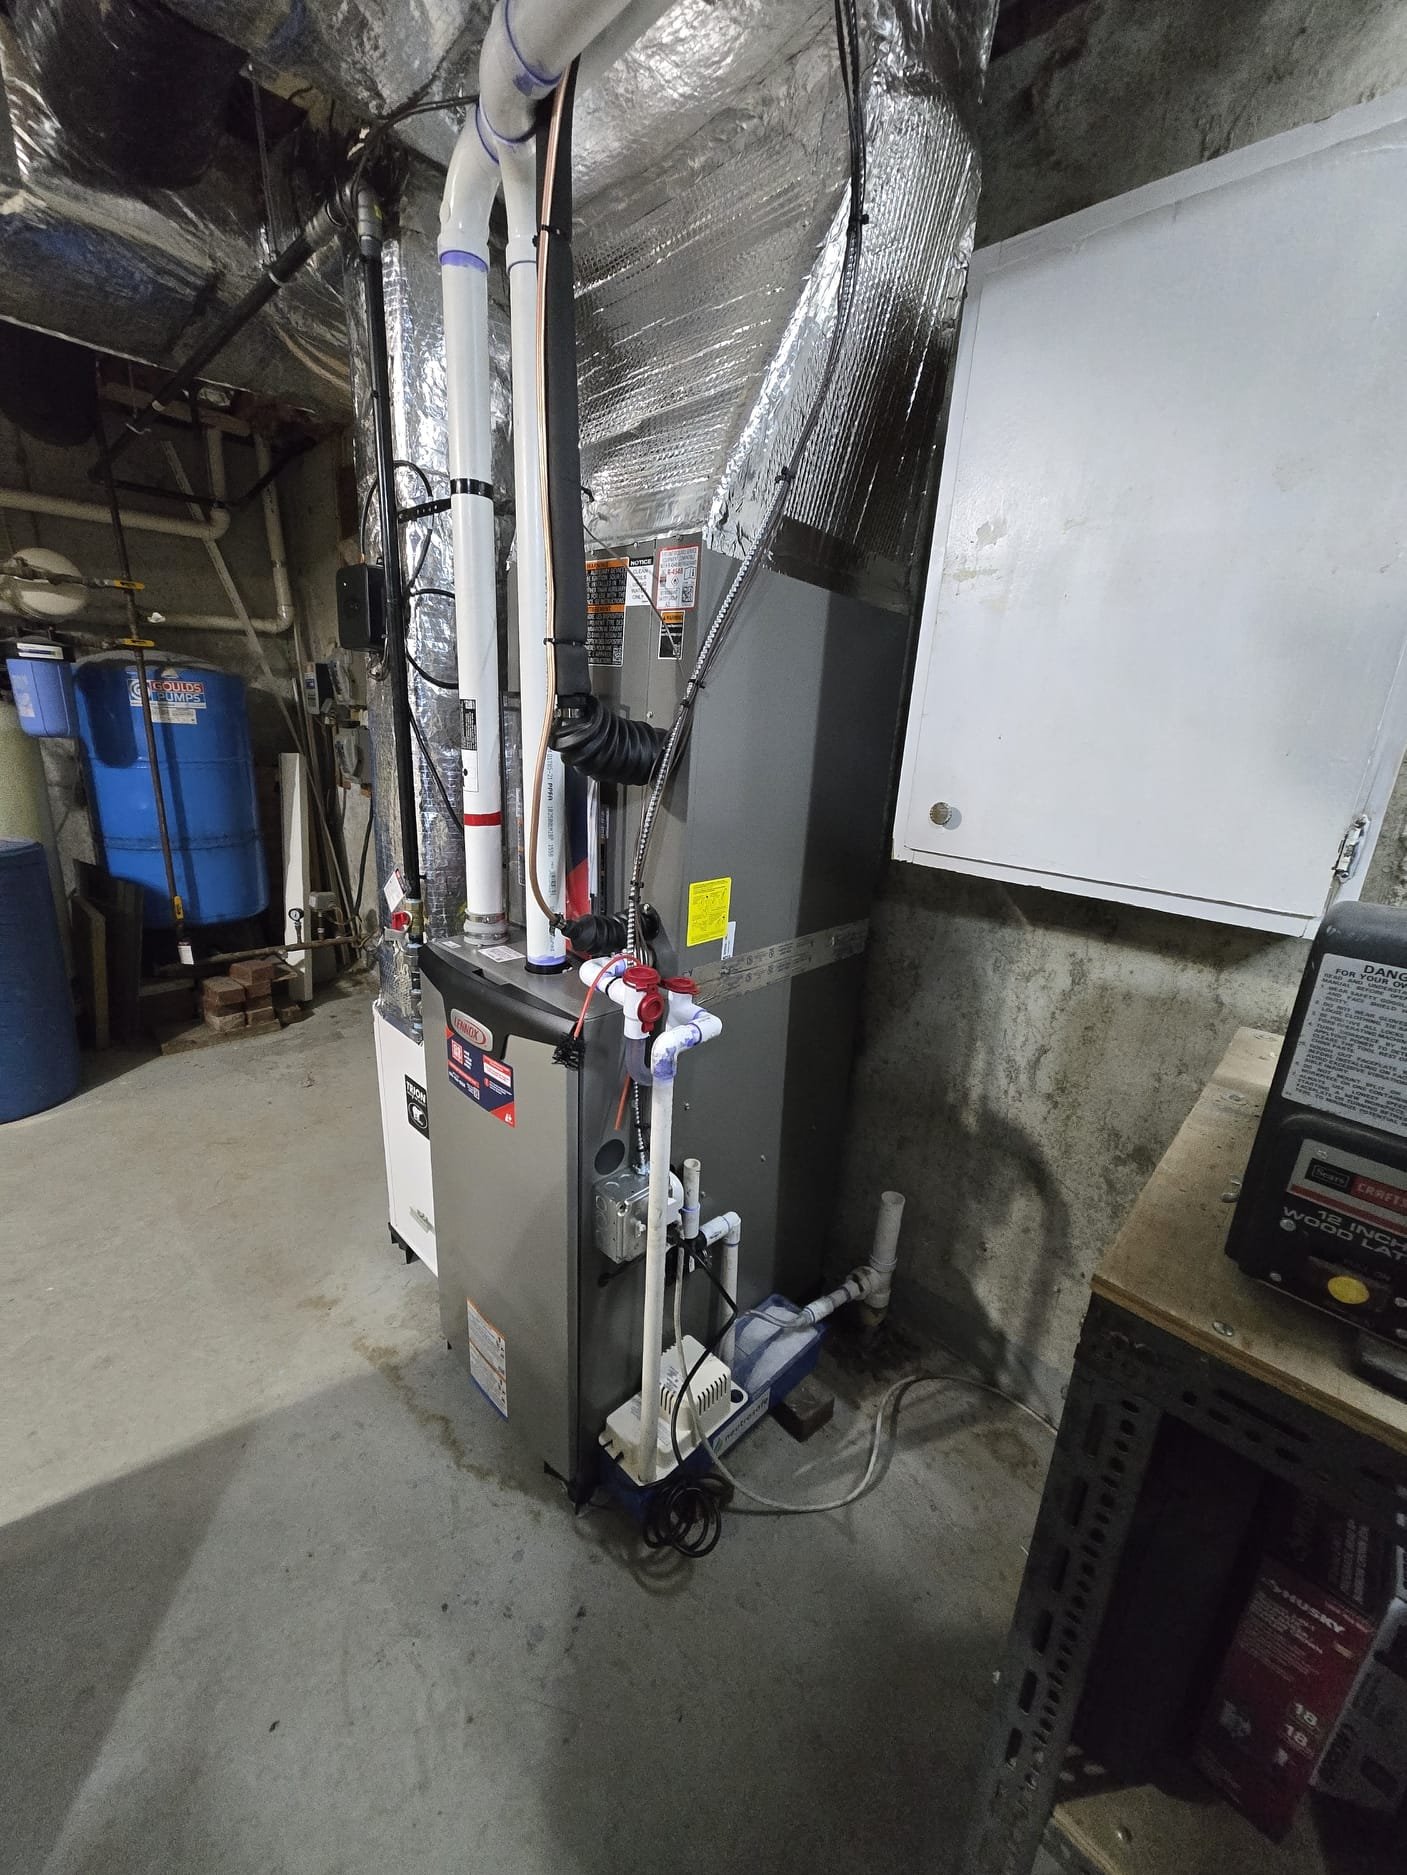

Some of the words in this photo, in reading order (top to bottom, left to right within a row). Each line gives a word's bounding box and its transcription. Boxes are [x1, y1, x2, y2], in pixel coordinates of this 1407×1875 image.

[630, 558, 652, 567] NOTICE
[152, 681, 202, 693] GOULDS
[152, 692, 201, 703] PUMPS
[1335, 969, 1356, 978] FOR
[1360, 974, 1389, 985] YOUR
[454, 1016, 479, 1041] LENNOX
[406, 1081, 426, 1104] TRION
[1282, 1206, 1353, 1241] WOOD
[1318, 1210, 1342, 1227] 12
[1280, 1587, 1346, 1636] HUSKY
[1295, 1702, 1318, 1727] 18
[1285, 1723, 1308, 1747] 18
